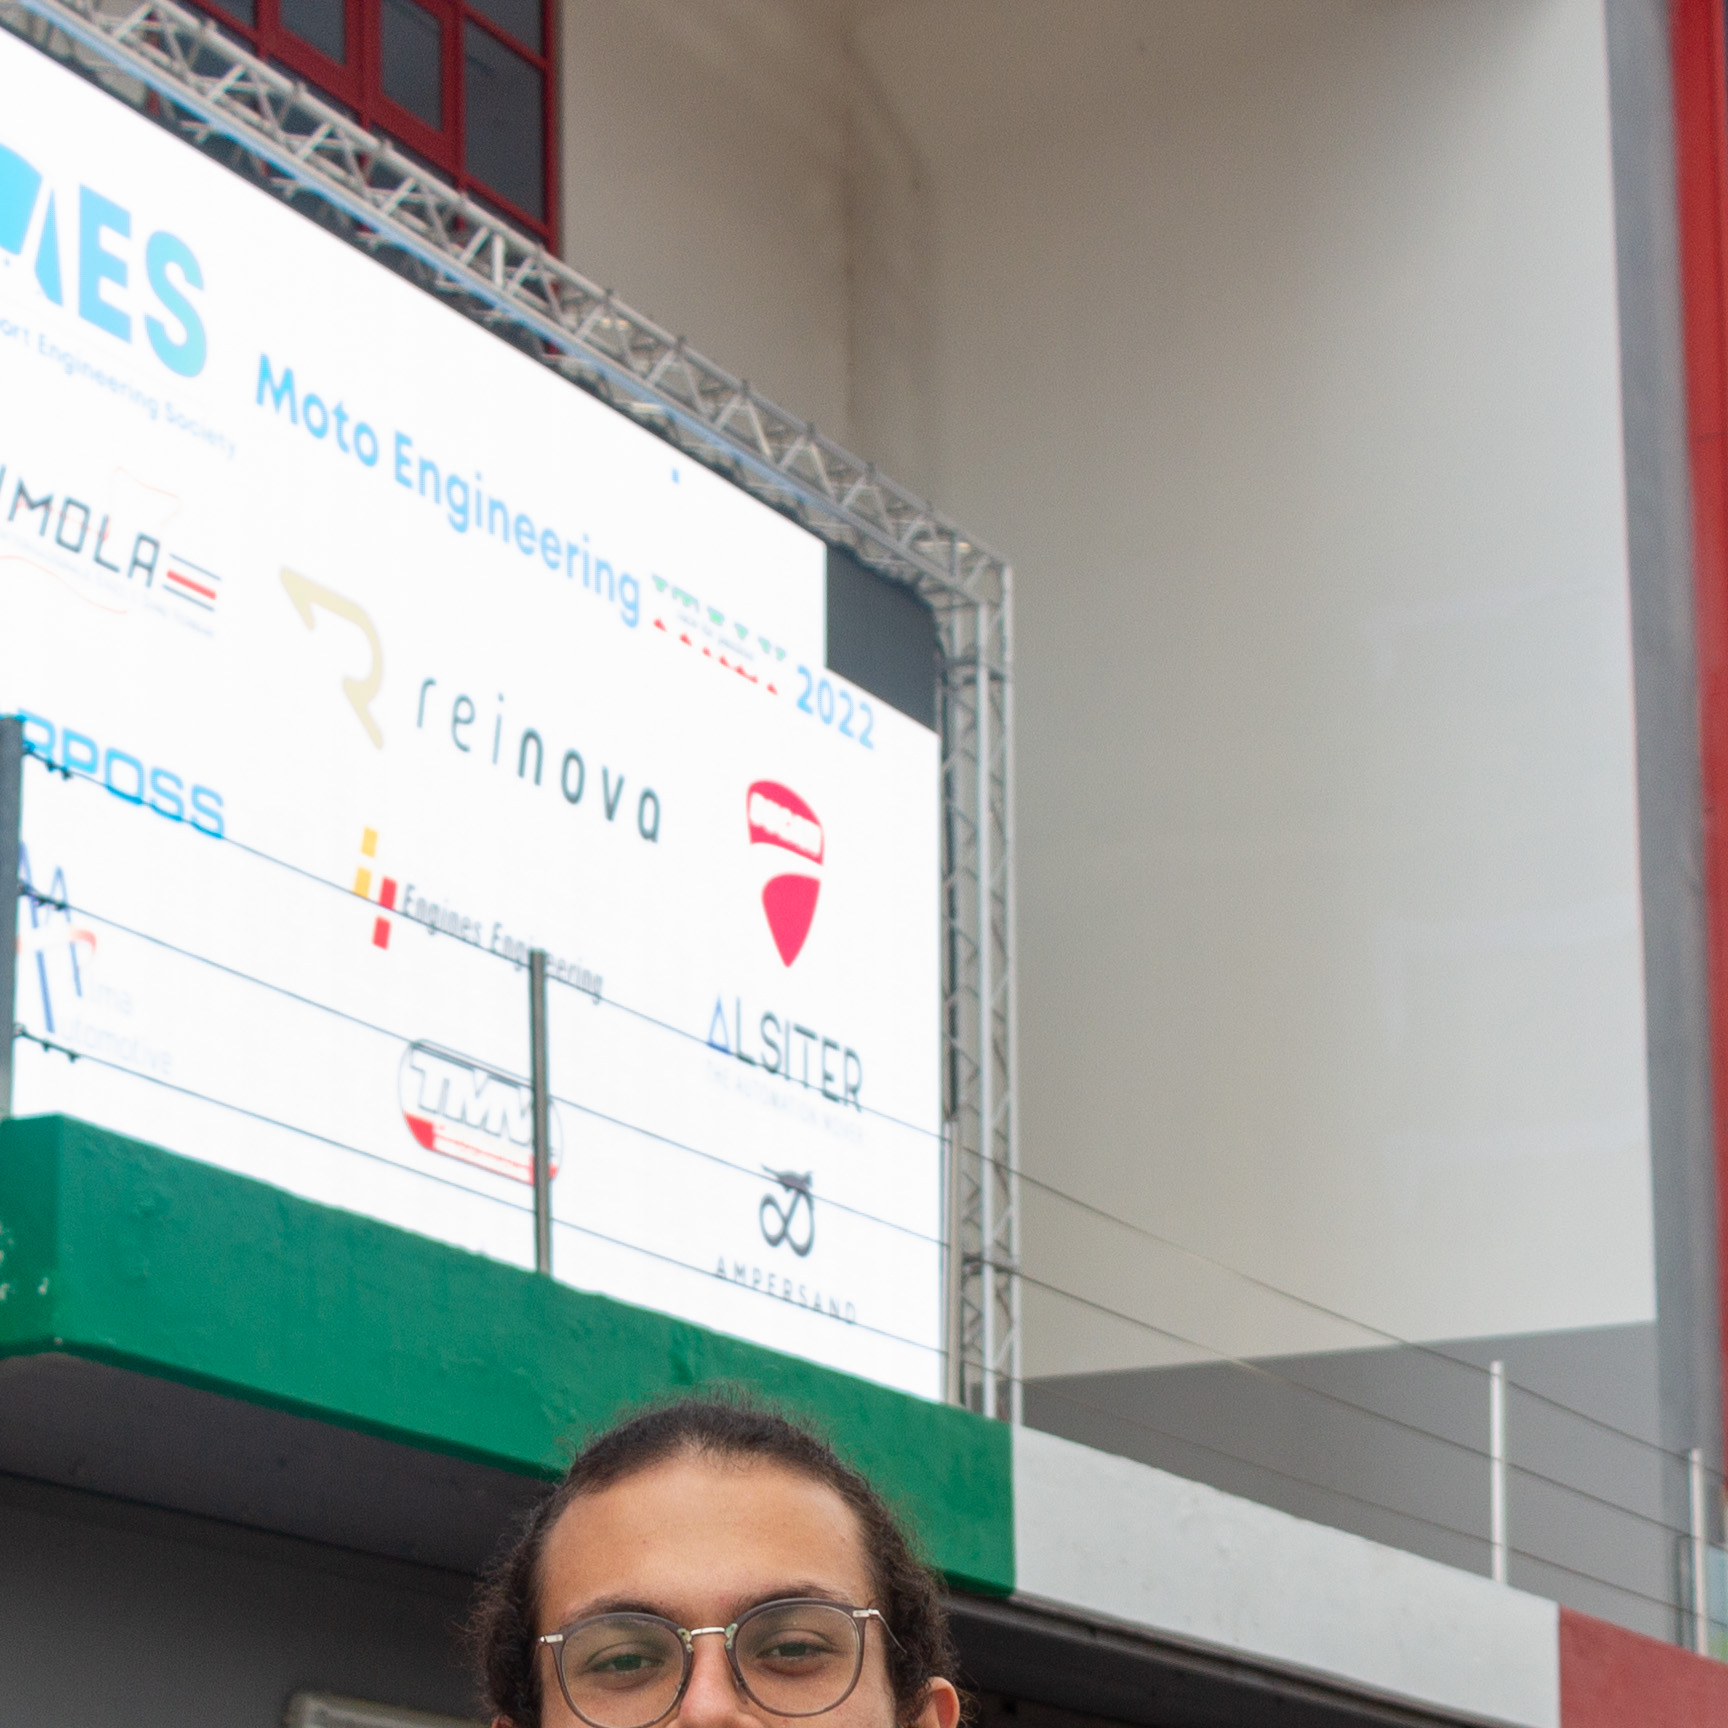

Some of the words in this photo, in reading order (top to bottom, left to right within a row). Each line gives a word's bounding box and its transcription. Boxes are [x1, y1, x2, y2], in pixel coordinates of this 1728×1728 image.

[37, 332, 159, 421] Engineering
[164, 401, 238, 460] Society
[255, 352, 381, 469] Moto
[393, 429, 641, 630] Engineering
[415, 675, 662, 845] reinova
[795, 663, 875, 750] 2022
[714, 1255, 858, 1327] AMPERSAND
